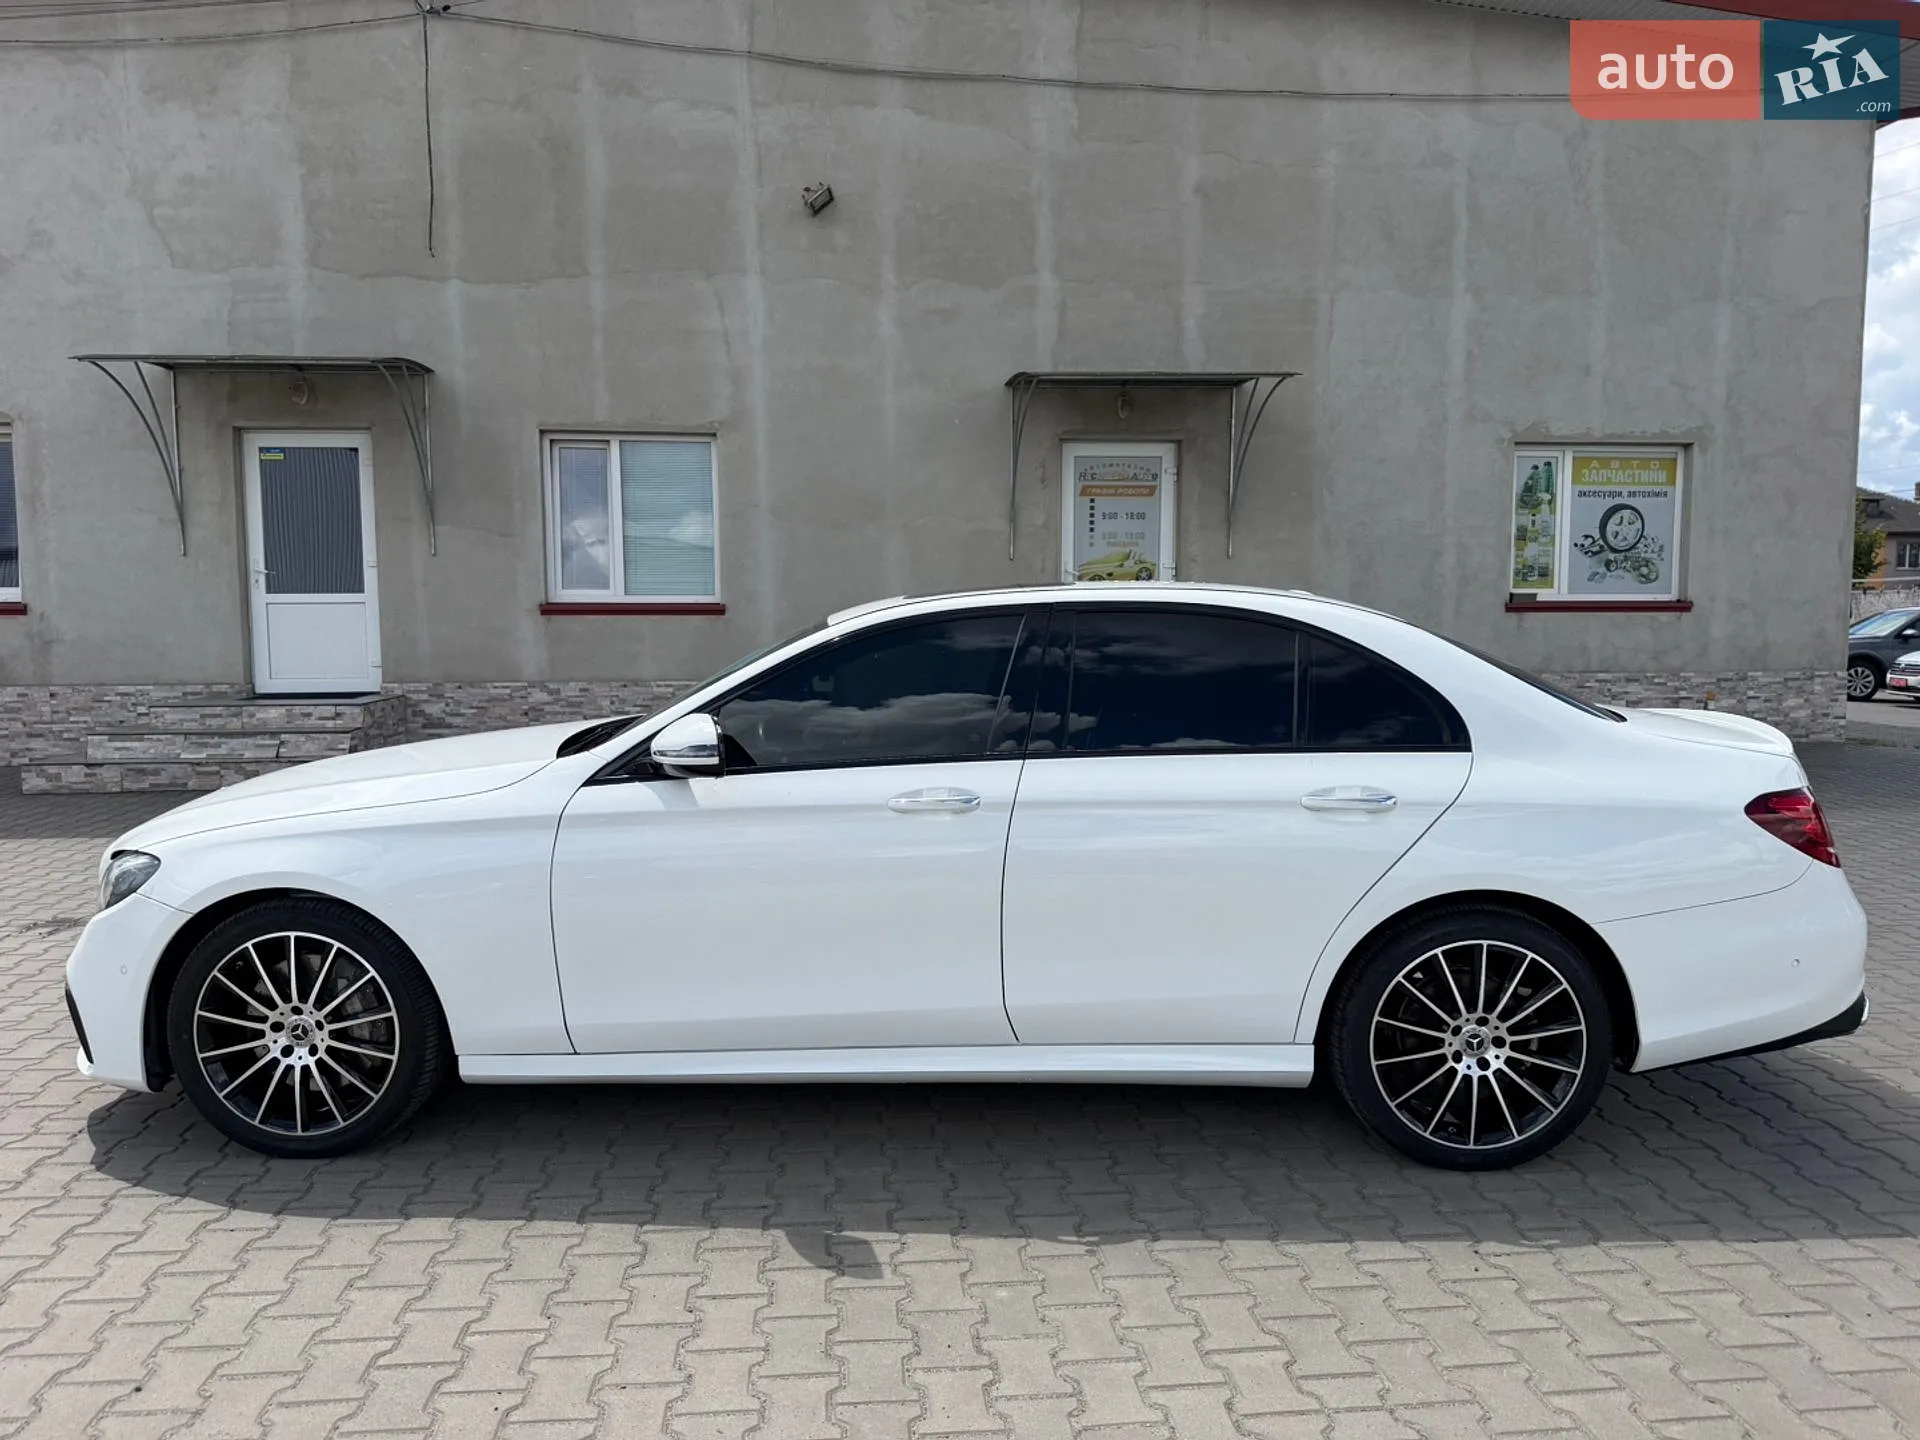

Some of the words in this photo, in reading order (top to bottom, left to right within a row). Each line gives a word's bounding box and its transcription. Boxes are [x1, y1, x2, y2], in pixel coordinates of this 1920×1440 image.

[1581, 468, 1667, 483] ЗАПЧАСТИНИ
[1627, 489, 1668, 498] автохімія
[1102, 512, 1118, 520] 9:00
[1125, 512, 1146, 520] 18:00
